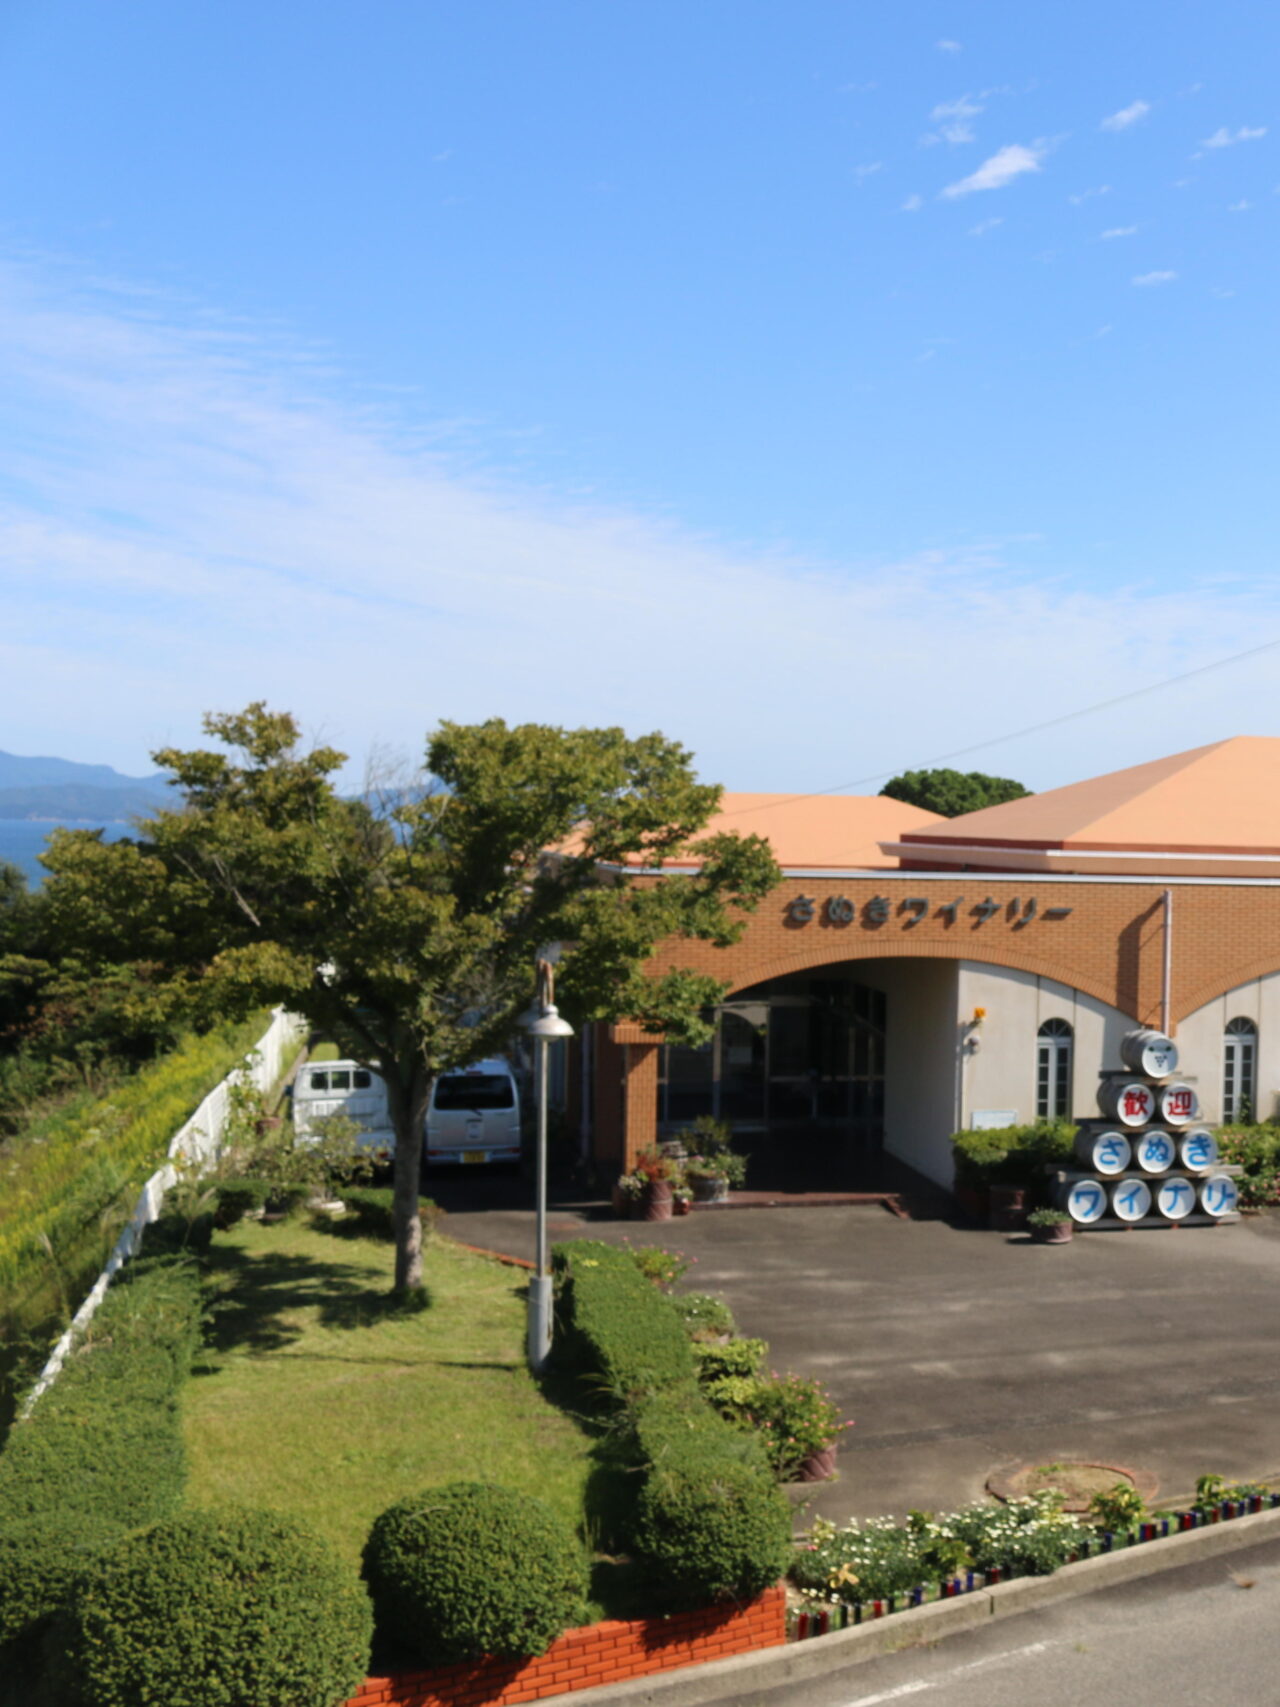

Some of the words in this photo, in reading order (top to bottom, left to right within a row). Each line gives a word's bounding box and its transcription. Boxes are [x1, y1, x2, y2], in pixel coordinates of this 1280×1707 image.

[789, 895, 1073, 926] さぬきワイナリー
[1123, 1090, 1193, 1117] 歓迎
[1099, 1135, 1212, 1166] さぬき
